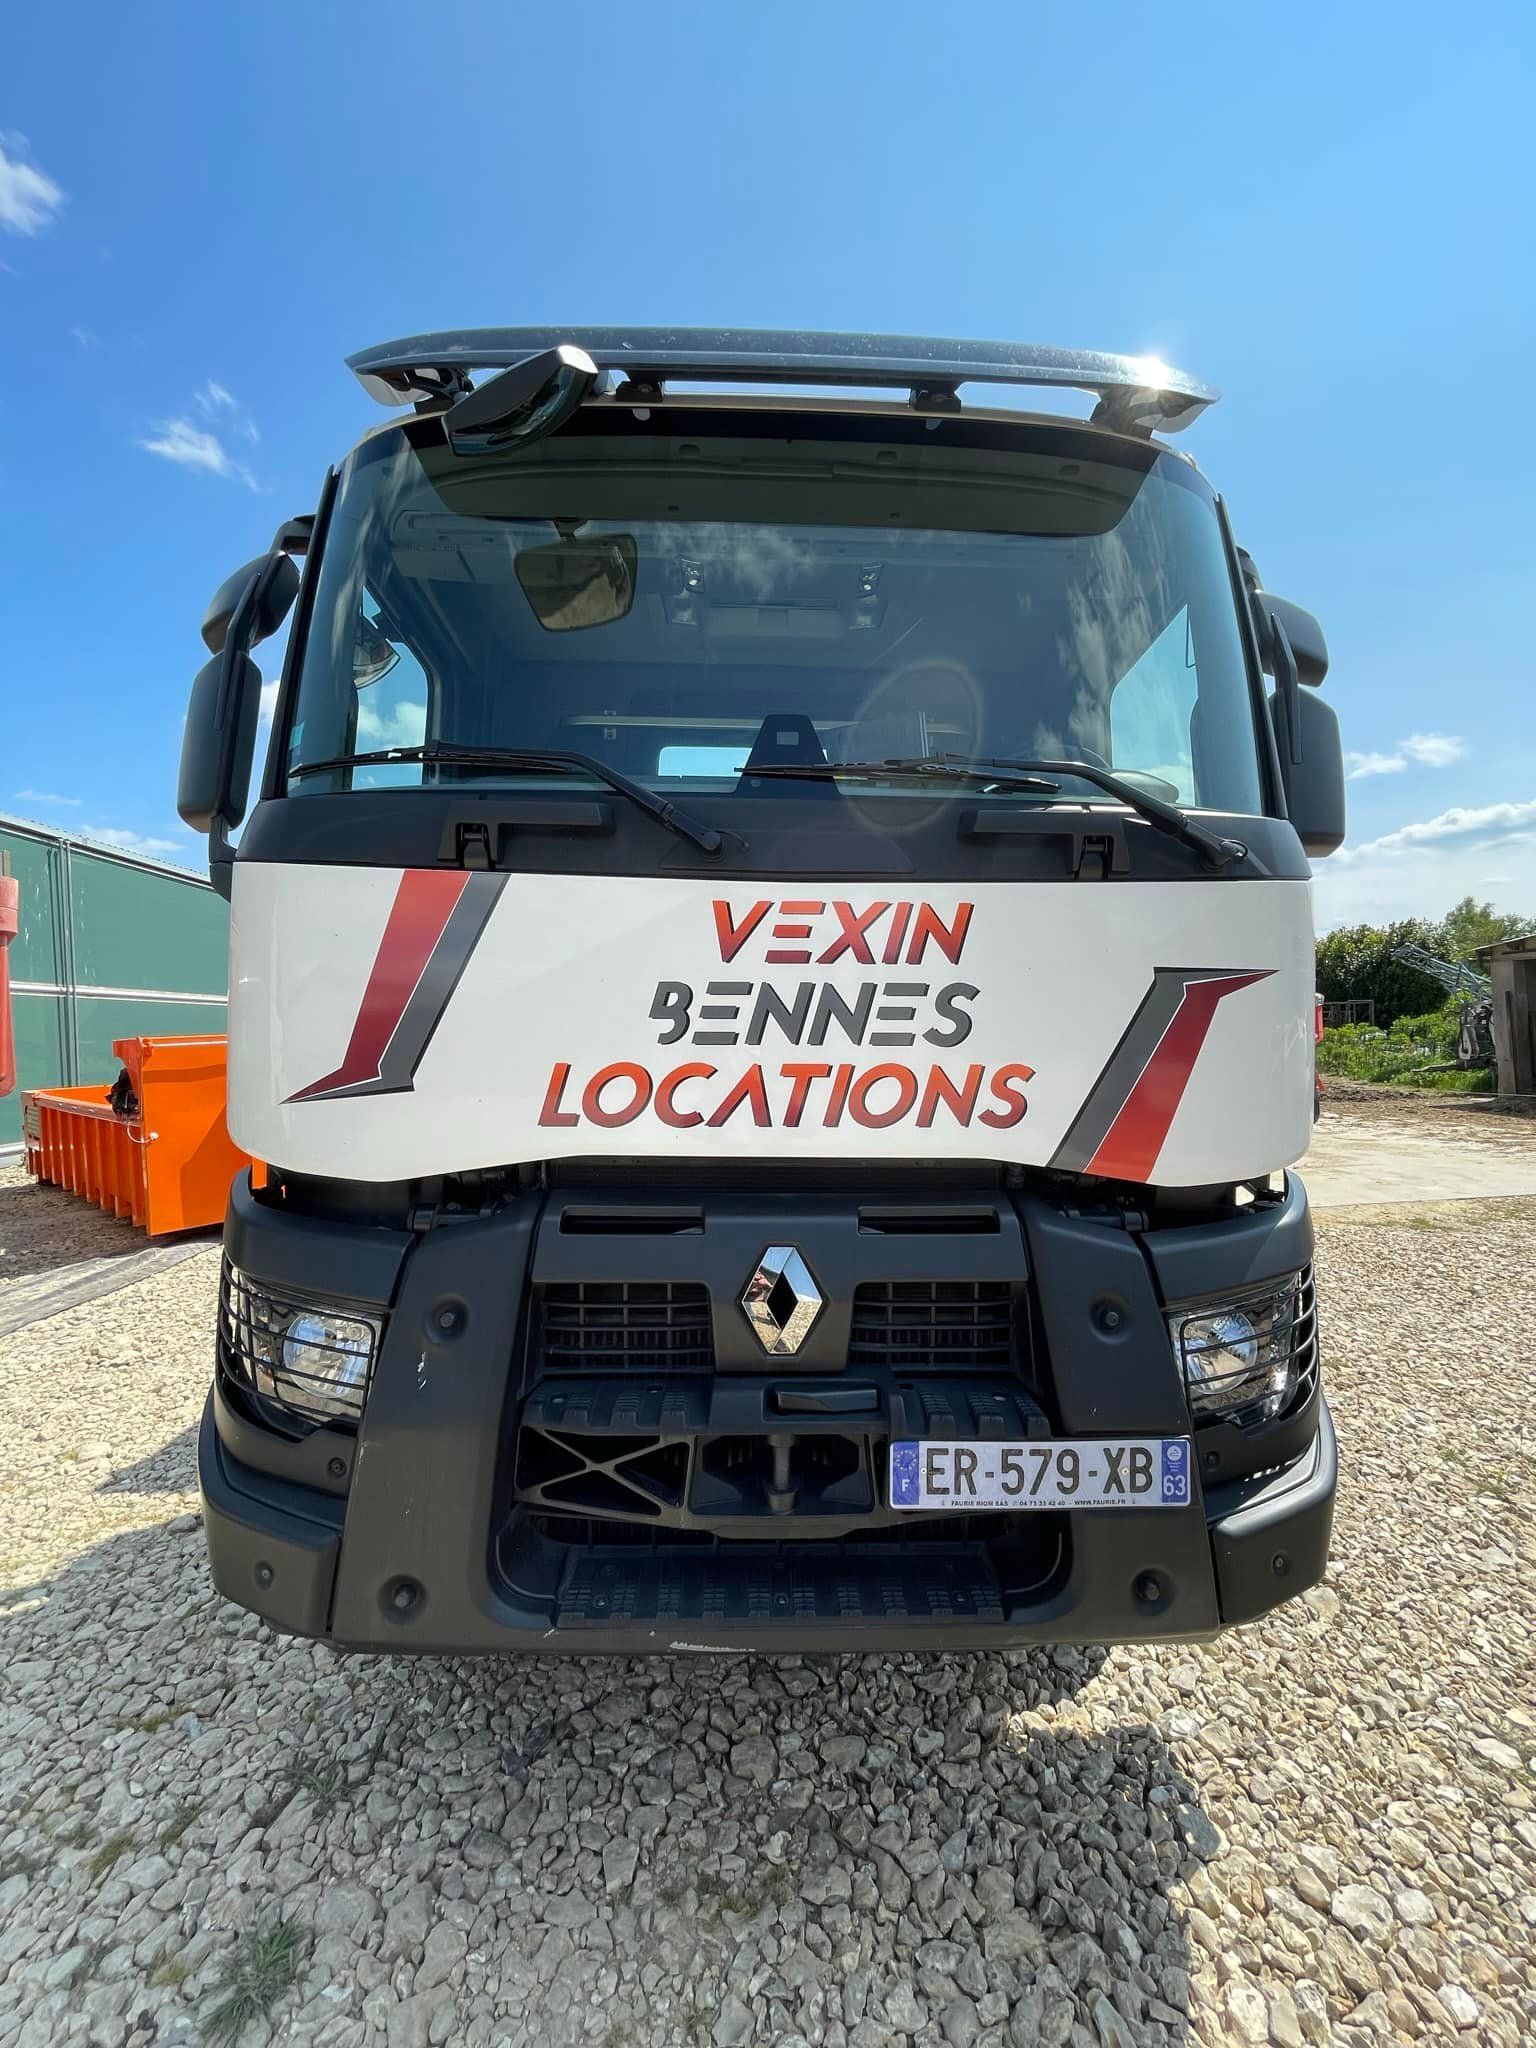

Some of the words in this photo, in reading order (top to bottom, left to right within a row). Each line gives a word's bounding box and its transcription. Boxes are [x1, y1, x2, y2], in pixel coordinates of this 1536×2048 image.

[713, 900, 975, 965] VEXIN
[648, 981, 981, 1047] BENNES
[537, 1061, 1038, 1129] LOCATIONS
[901, 1478, 910, 1492] F
[926, 1447, 1153, 1495] ER-579-XB
[1163, 1475, 1186, 1496] 63
